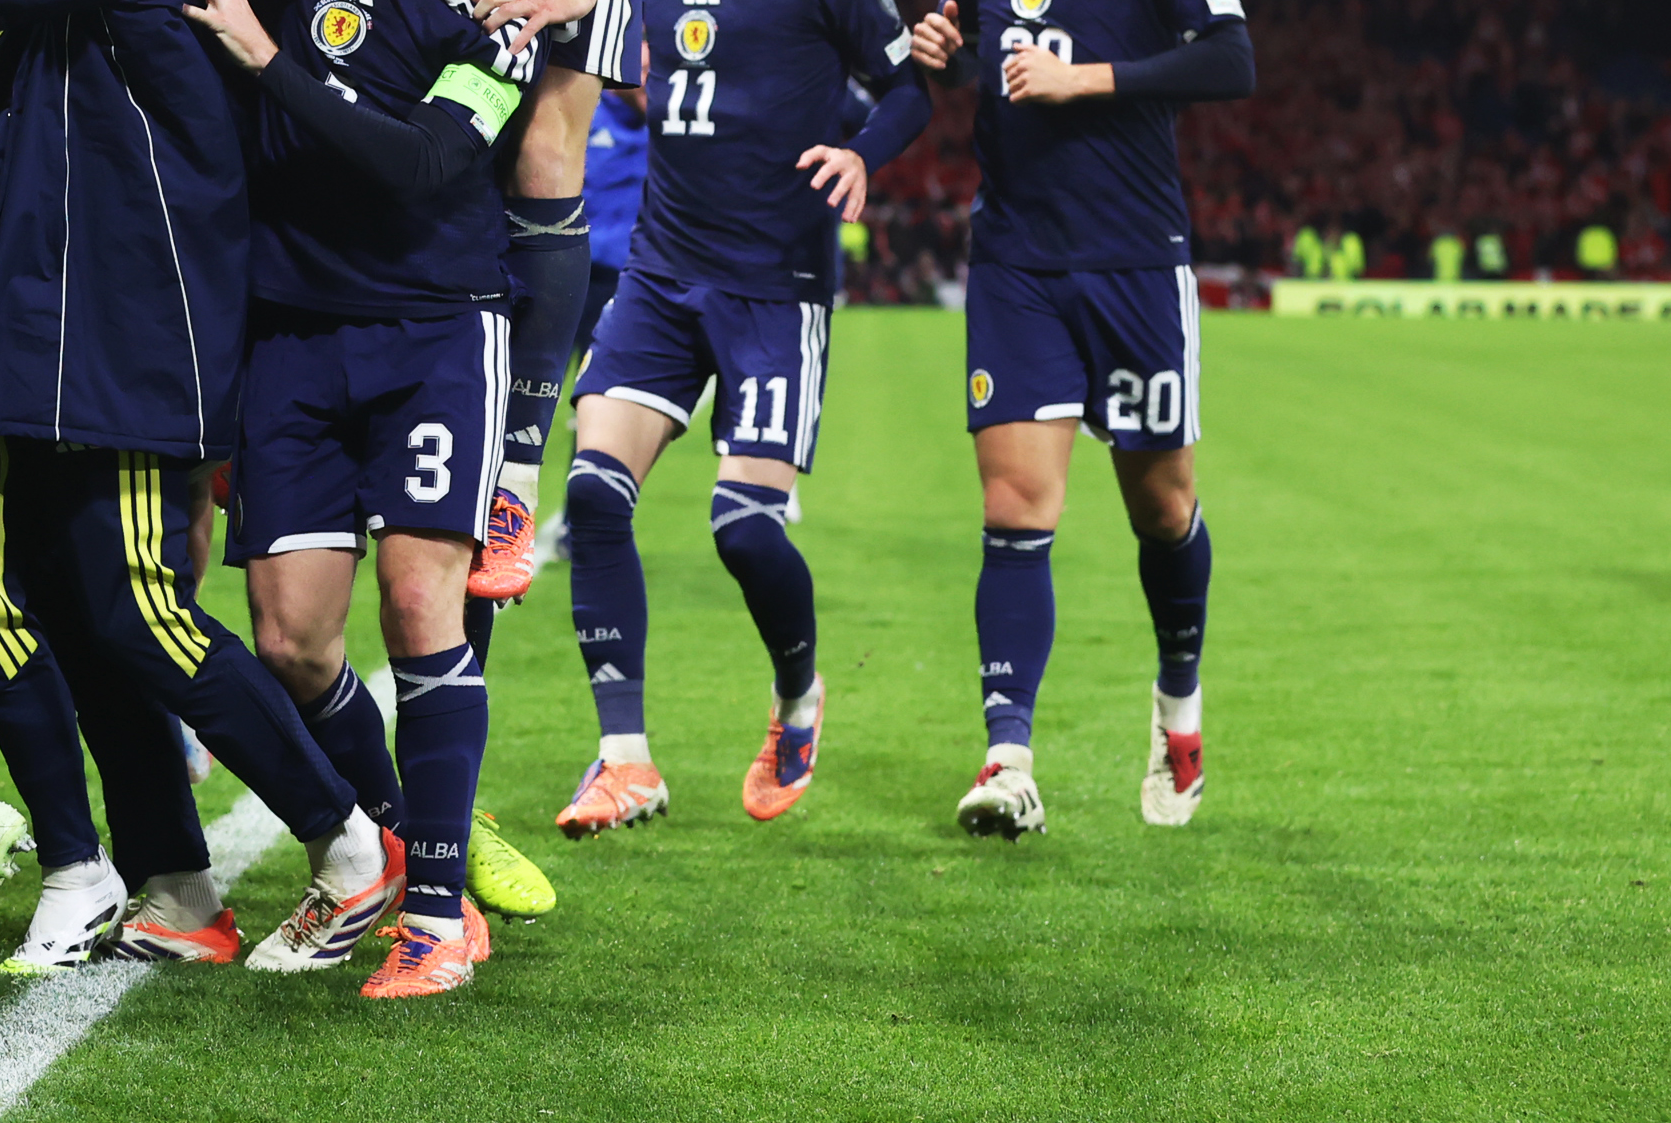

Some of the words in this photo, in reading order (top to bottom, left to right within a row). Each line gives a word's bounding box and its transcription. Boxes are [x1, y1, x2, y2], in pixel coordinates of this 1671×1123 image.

[662, 69, 716, 136] 11
[511, 378, 561, 399] ALBA
[1107, 368, 1181, 434] 20
[733, 376, 788, 446] 11
[404, 423, 454, 503] 3
[979, 661, 1013, 677] LBA
[367, 801, 393, 819] BA
[411, 840, 460, 860] ALBA
